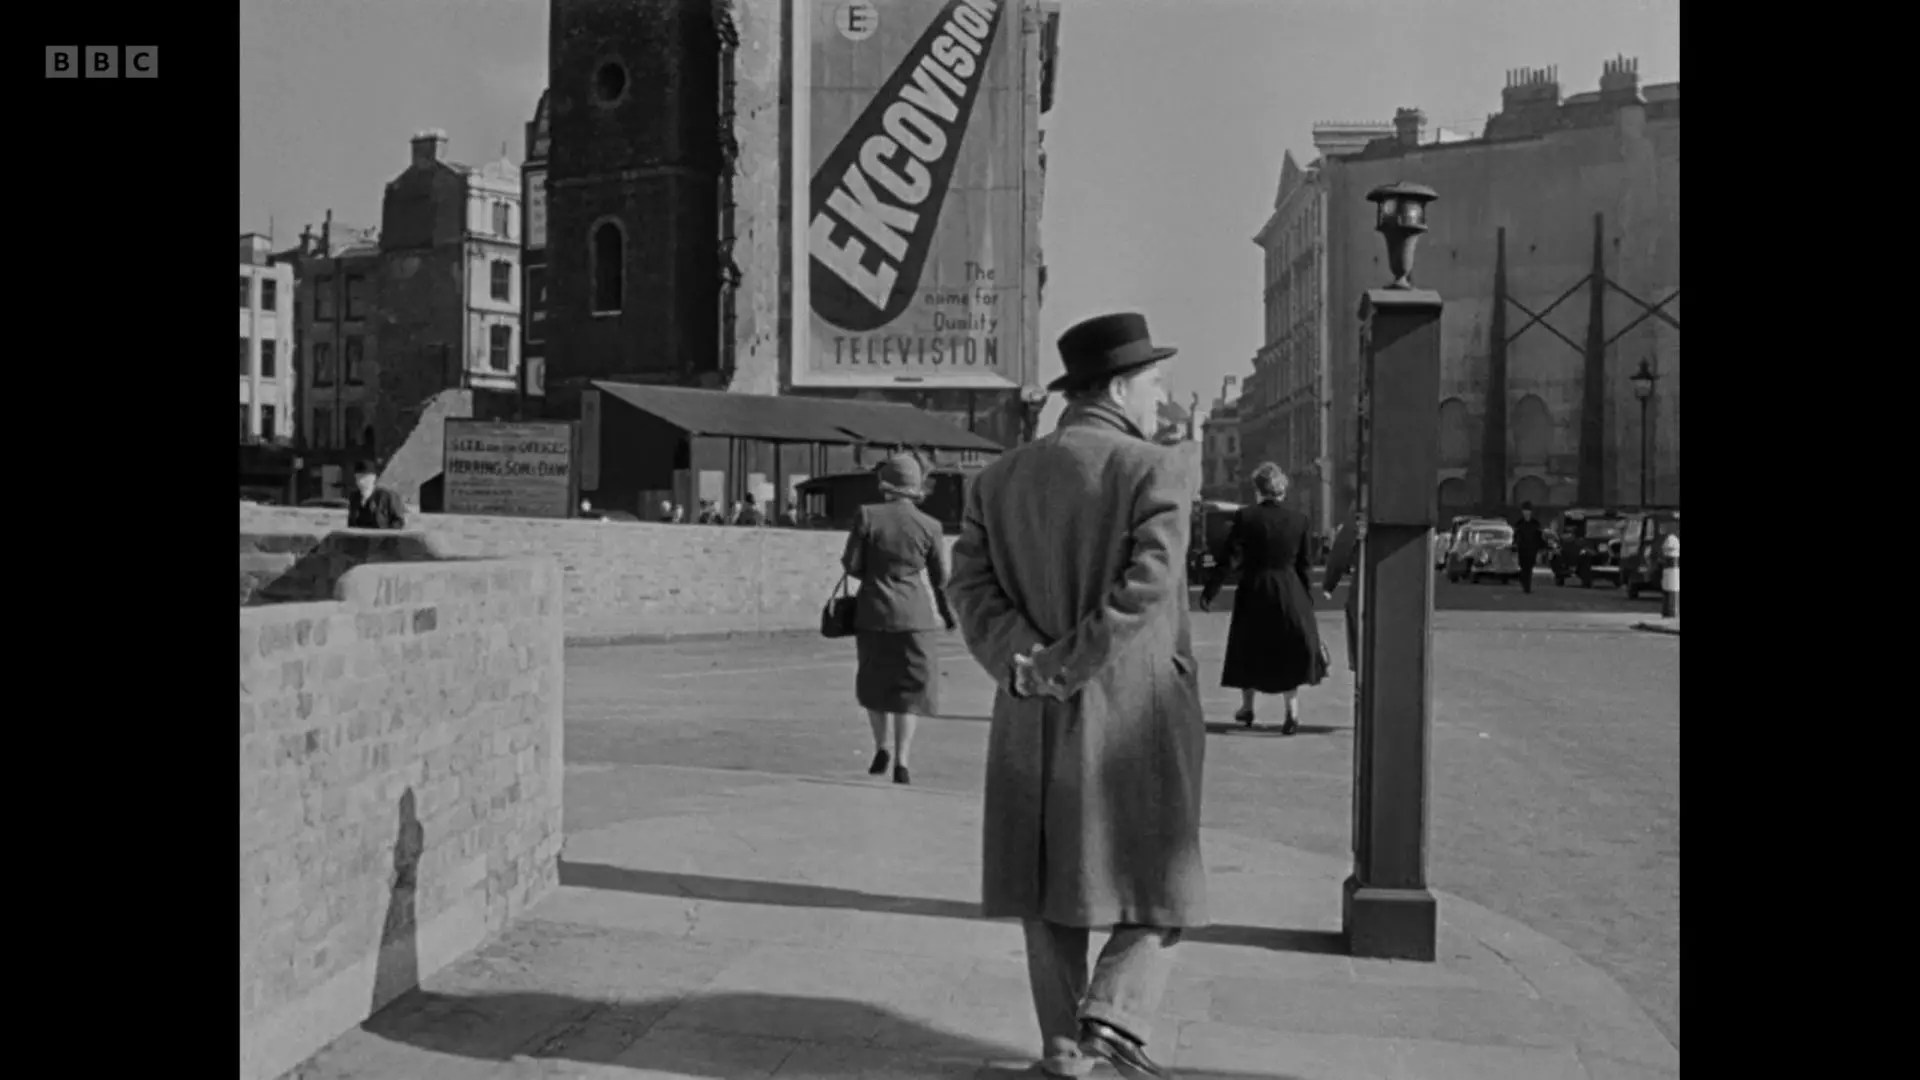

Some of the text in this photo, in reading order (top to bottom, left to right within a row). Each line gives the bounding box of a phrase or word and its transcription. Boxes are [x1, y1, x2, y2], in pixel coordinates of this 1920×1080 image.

[808, 0, 998, 311] EKCOVISION
[964, 261, 995, 282] The
[924, 287, 998, 306] name for
[933, 311, 998, 334] Quality
[834, 336, 998, 366] TELEVISION
